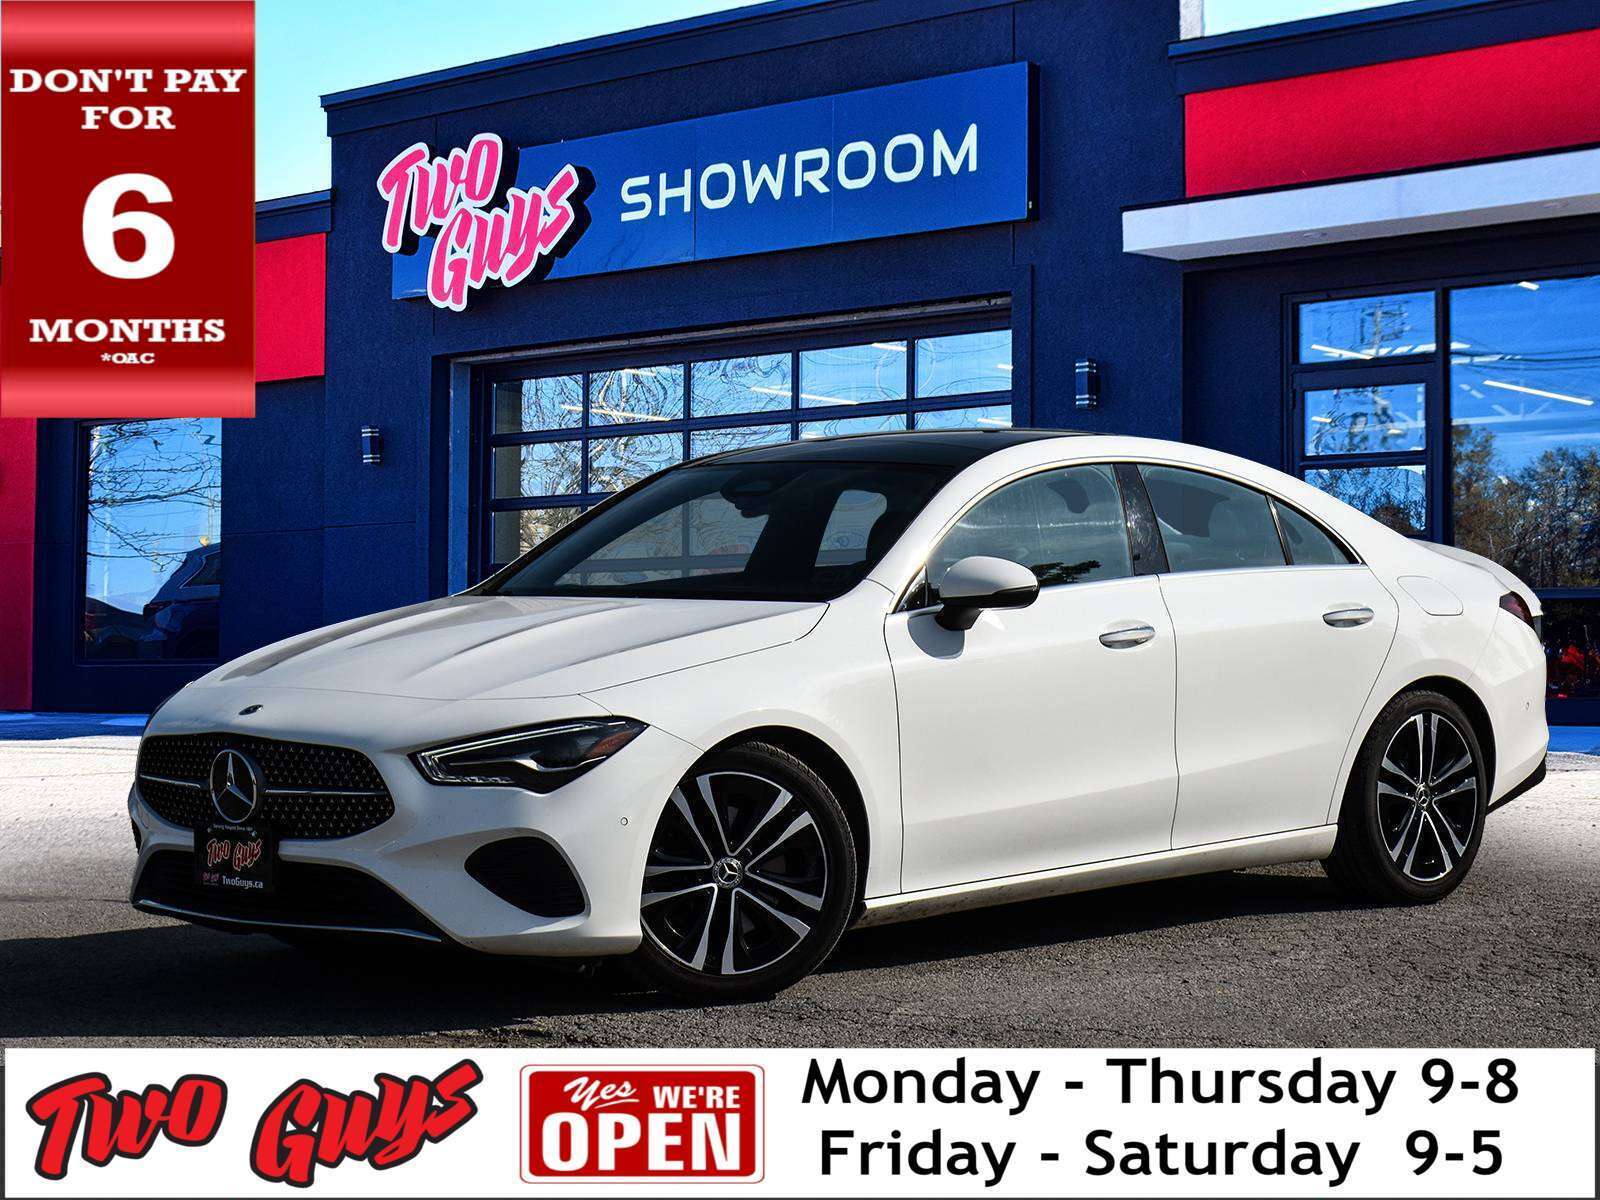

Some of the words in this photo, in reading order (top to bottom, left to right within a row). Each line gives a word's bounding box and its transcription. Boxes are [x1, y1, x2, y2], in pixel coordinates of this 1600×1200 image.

[376, 131, 504, 255] Two
[620, 122, 978, 222] SHOWROOM
[425, 162, 580, 313] Guys
[222, 875, 264, 889] TwoGuys.ca
